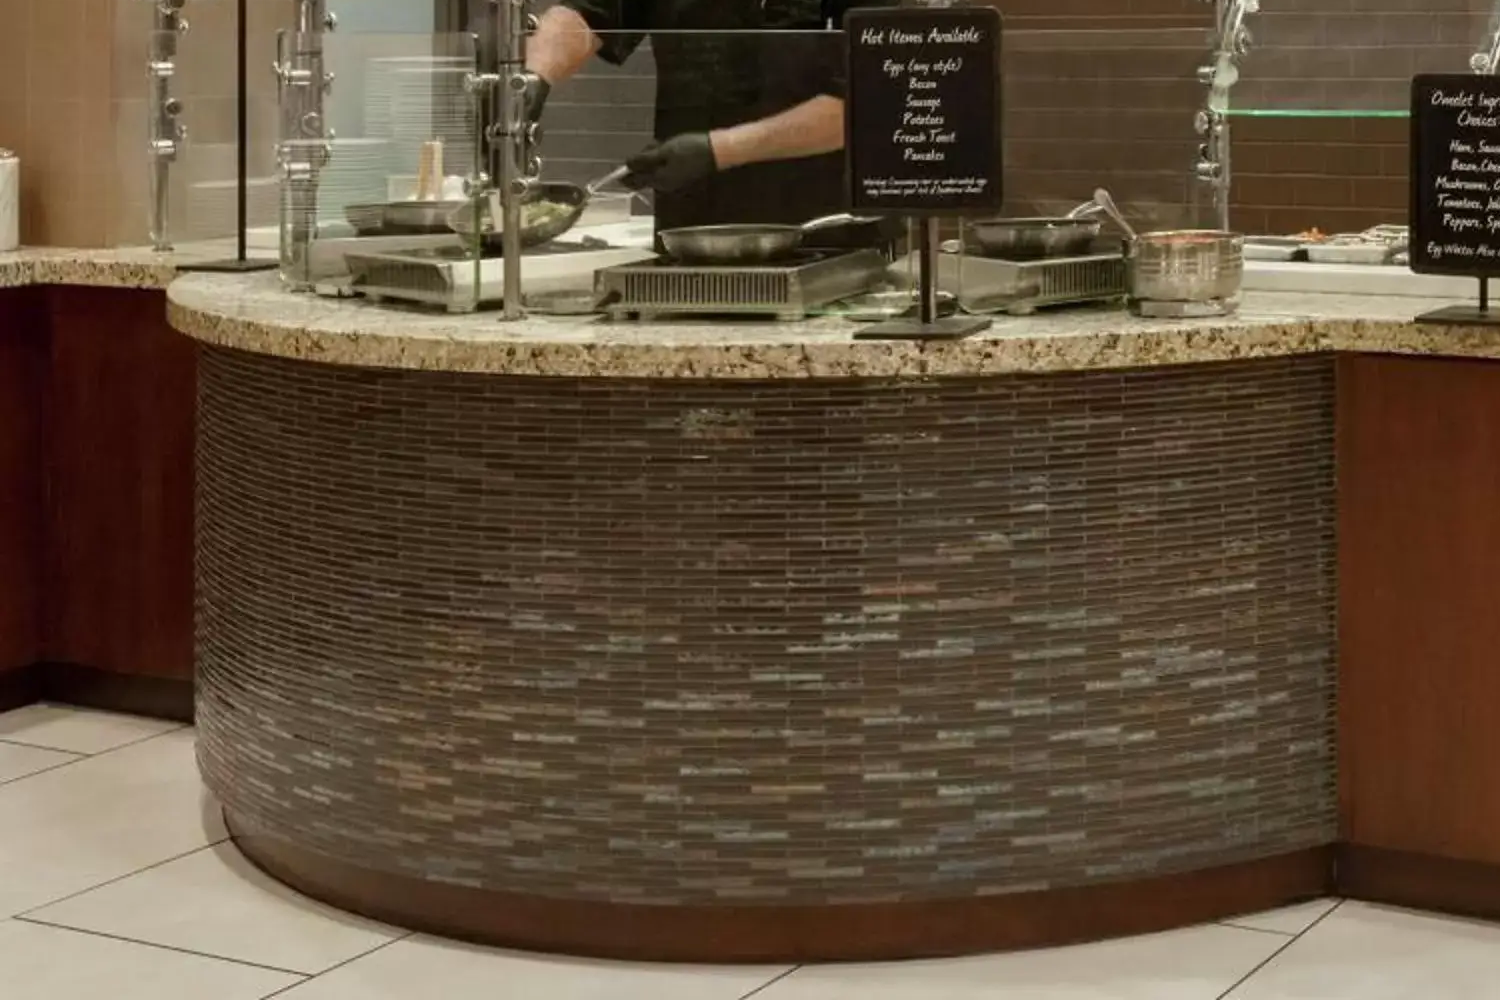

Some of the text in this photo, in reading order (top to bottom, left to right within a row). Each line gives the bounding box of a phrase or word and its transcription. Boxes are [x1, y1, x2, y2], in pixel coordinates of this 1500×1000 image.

[861, 27, 884, 45] Hot
[889, 27, 923, 44] Items
[883, 59, 905, 77] Eggs
[932, 57, 963, 76] style)
[909, 77, 937, 90] Bacon
[906, 94, 941, 112] Sausage
[1431, 89, 1473, 107] Omelet
[903, 112, 944, 125] Potatoes
[893, 127, 956, 143] French Toast
[904, 148, 945, 161] Pancakes
